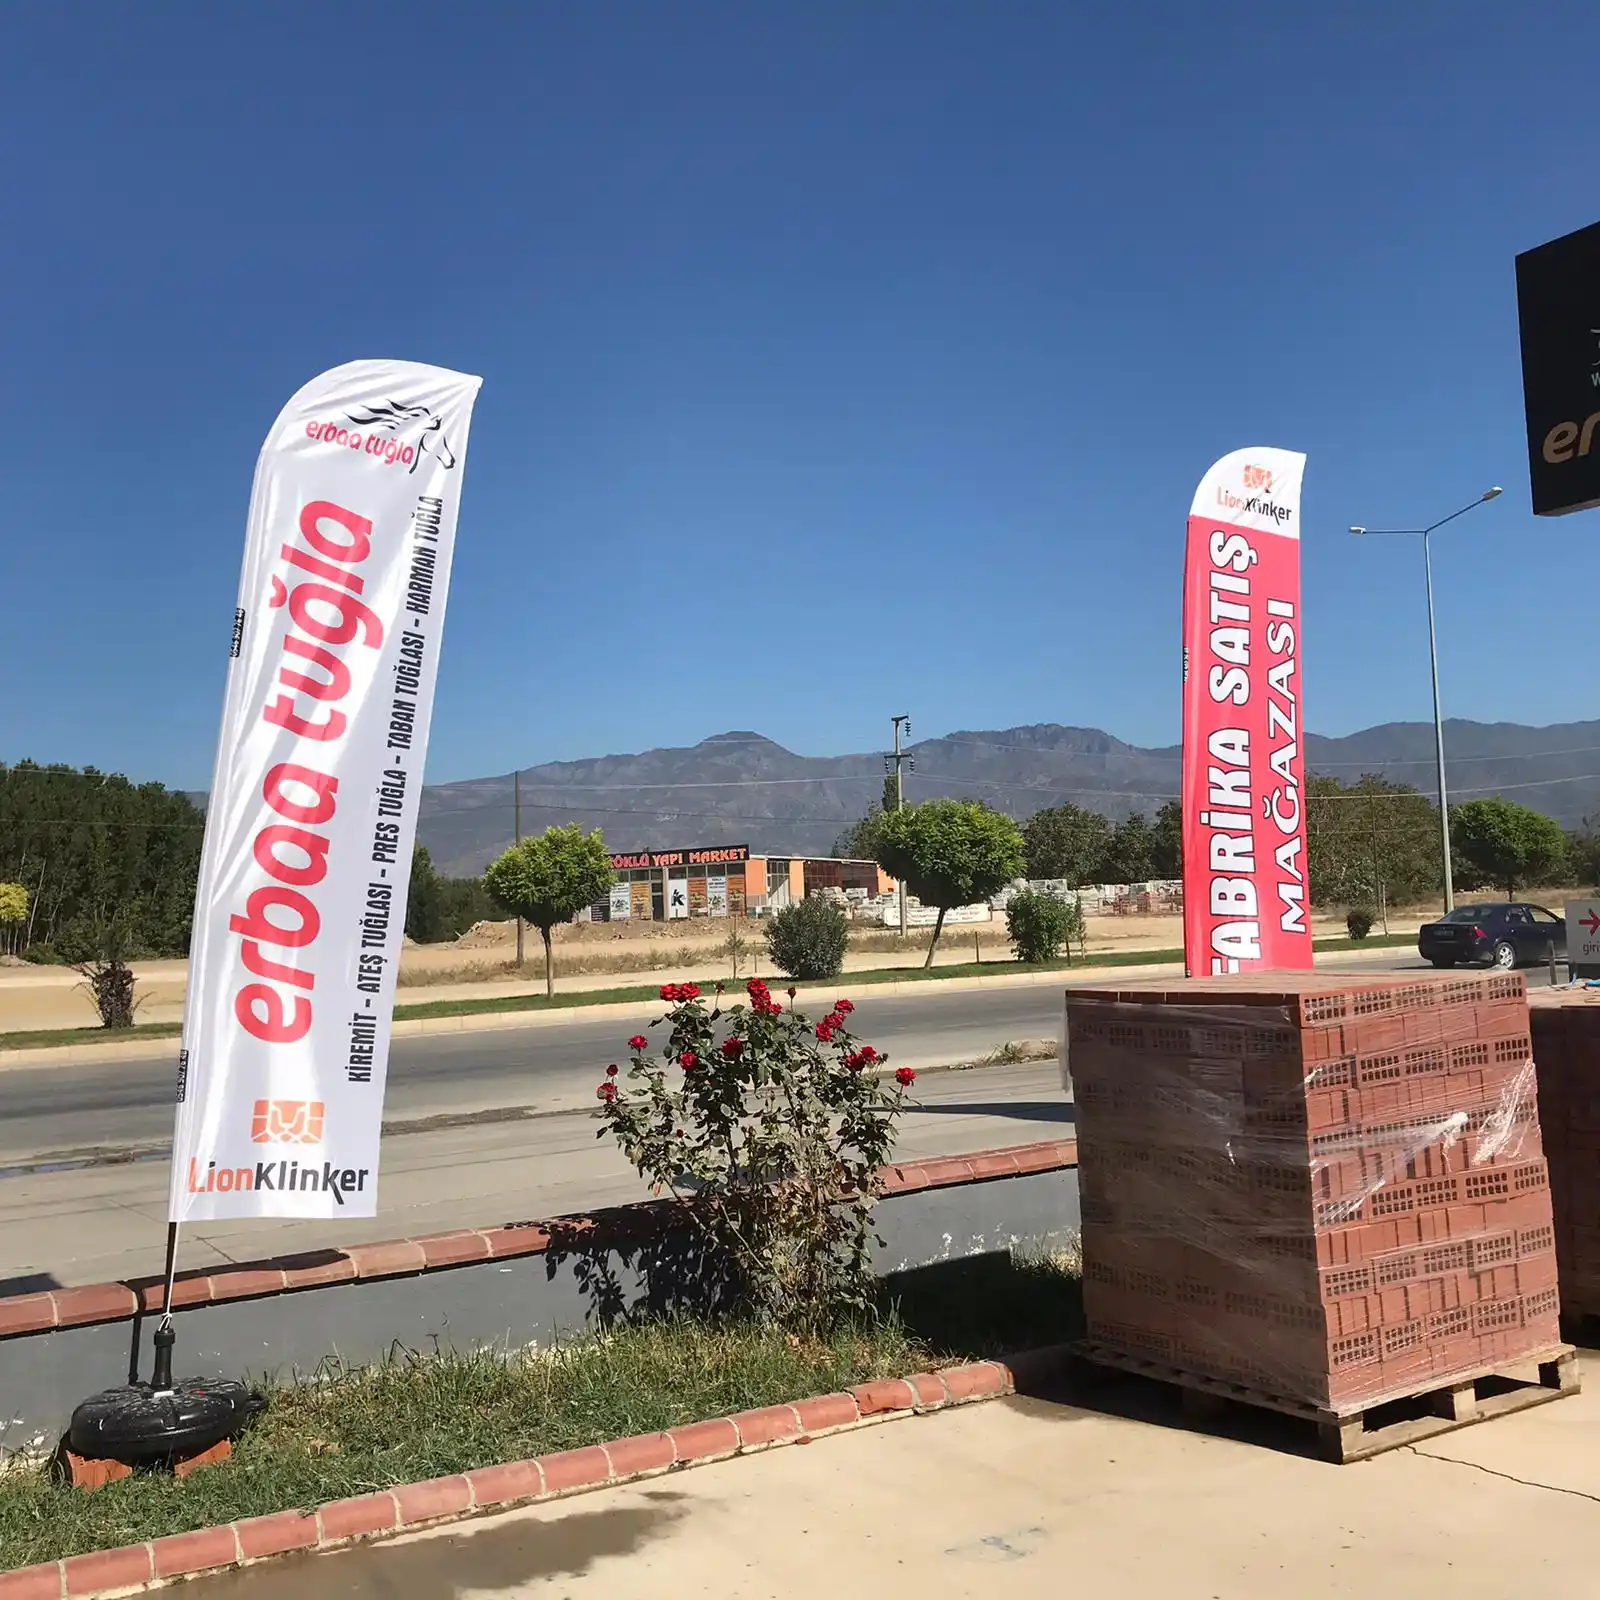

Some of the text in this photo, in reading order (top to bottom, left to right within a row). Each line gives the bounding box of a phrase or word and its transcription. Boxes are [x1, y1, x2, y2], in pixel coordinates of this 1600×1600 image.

[305, 420, 415, 465] erbaa tuğla
[411, 495, 443, 542] TUĞLA
[406, 545, 437, 615] HARMAN
[1208, 530, 1259, 706] SATIŞ
[392, 630, 425, 695] TUĞLASI
[387, 699, 416, 749] TABAN
[229, 500, 384, 1043] erbaa tuğla
[1263, 598, 1307, 934] MAĞAZASI
[375, 769, 407, 817] TUĞLA
[372, 822, 400, 864] PRES
[652, 852, 683, 867] YAPI
[688, 847, 747, 864] MARKET
[359, 882, 393, 948] TUĞLASI
[356, 954, 388, 993] ATEŞ
[345, 1012, 377, 1082] KİREMİT
[187, 1156, 368, 1205] LionKlinker
